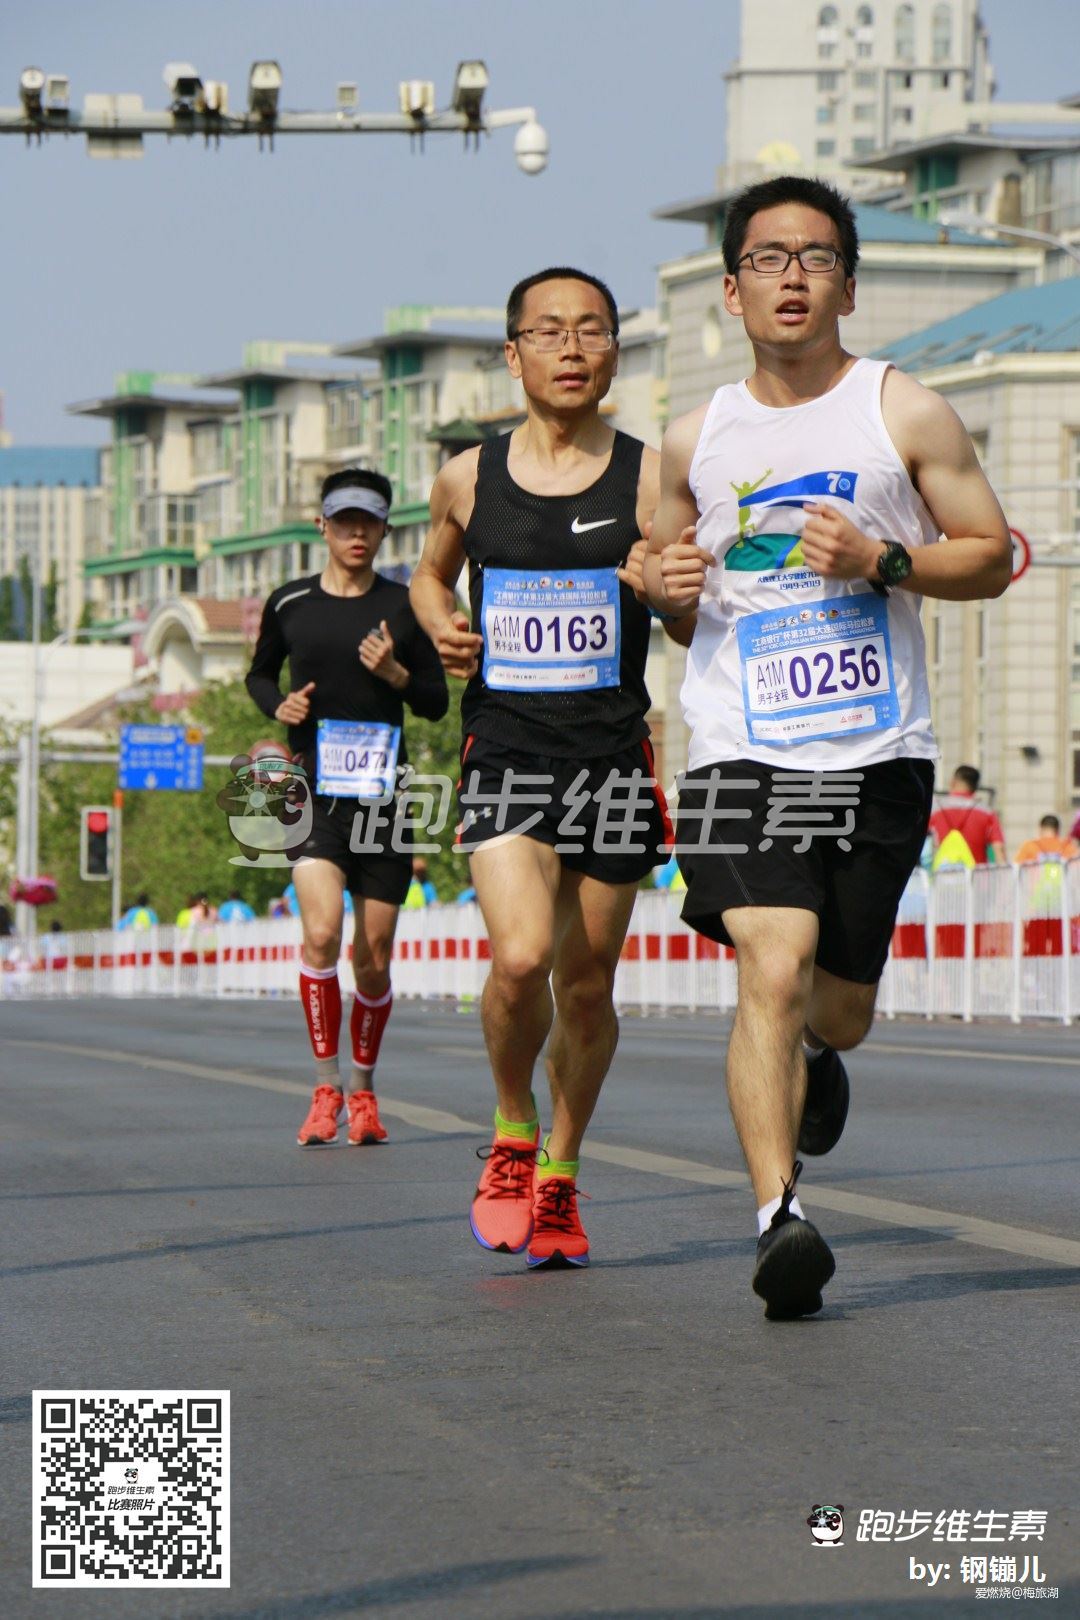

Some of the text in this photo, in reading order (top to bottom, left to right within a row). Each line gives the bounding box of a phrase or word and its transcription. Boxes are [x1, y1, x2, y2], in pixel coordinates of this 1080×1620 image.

[780, 580, 820, 590] 1949-2019
[493, 615, 608, 653] A1M 0163
[494, 641, 521, 653] 男子全程
[757, 644, 880, 698] A1M 0256
[758, 689, 789, 705] 男子全程
